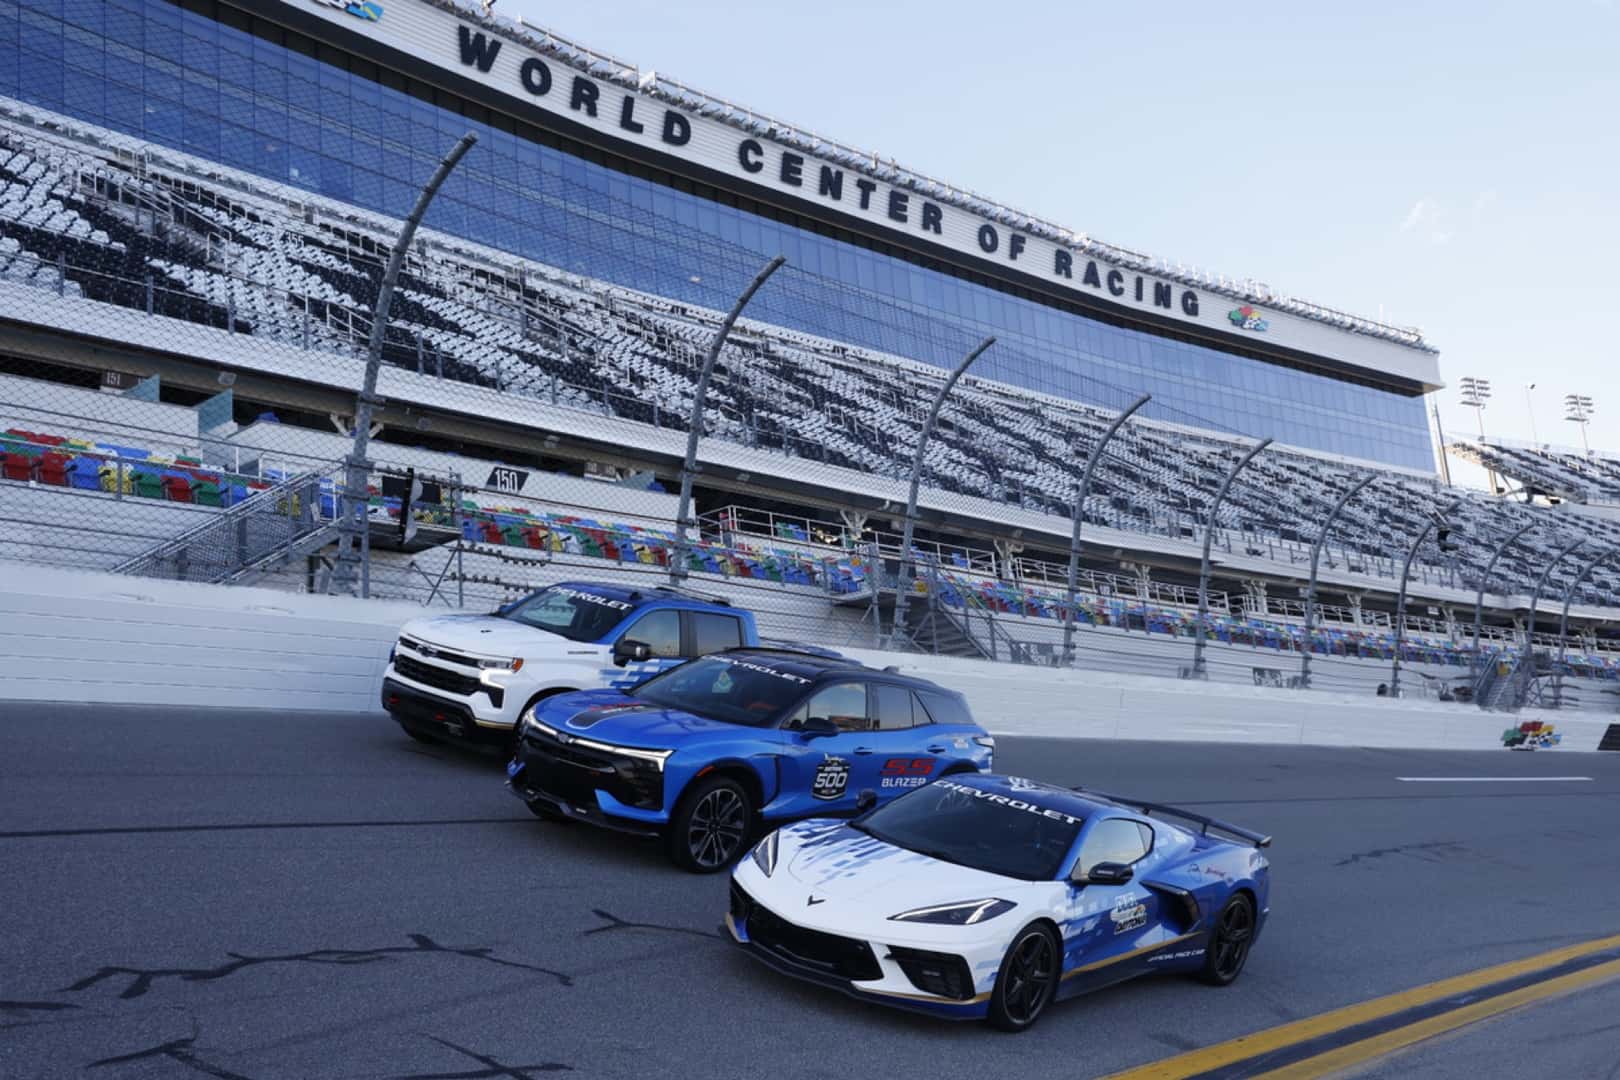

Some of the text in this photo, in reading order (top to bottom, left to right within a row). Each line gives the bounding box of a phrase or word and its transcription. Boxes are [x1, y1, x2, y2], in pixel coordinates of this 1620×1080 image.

[458, 24, 1199, 317] WORLD CENTER OF RACING
[494, 469, 519, 493] 150
[880, 758, 937, 775] SS
[814, 773, 848, 788] 500
[881, 777, 927, 788] BLAZER
[932, 780, 1081, 825] CHEVROLET
